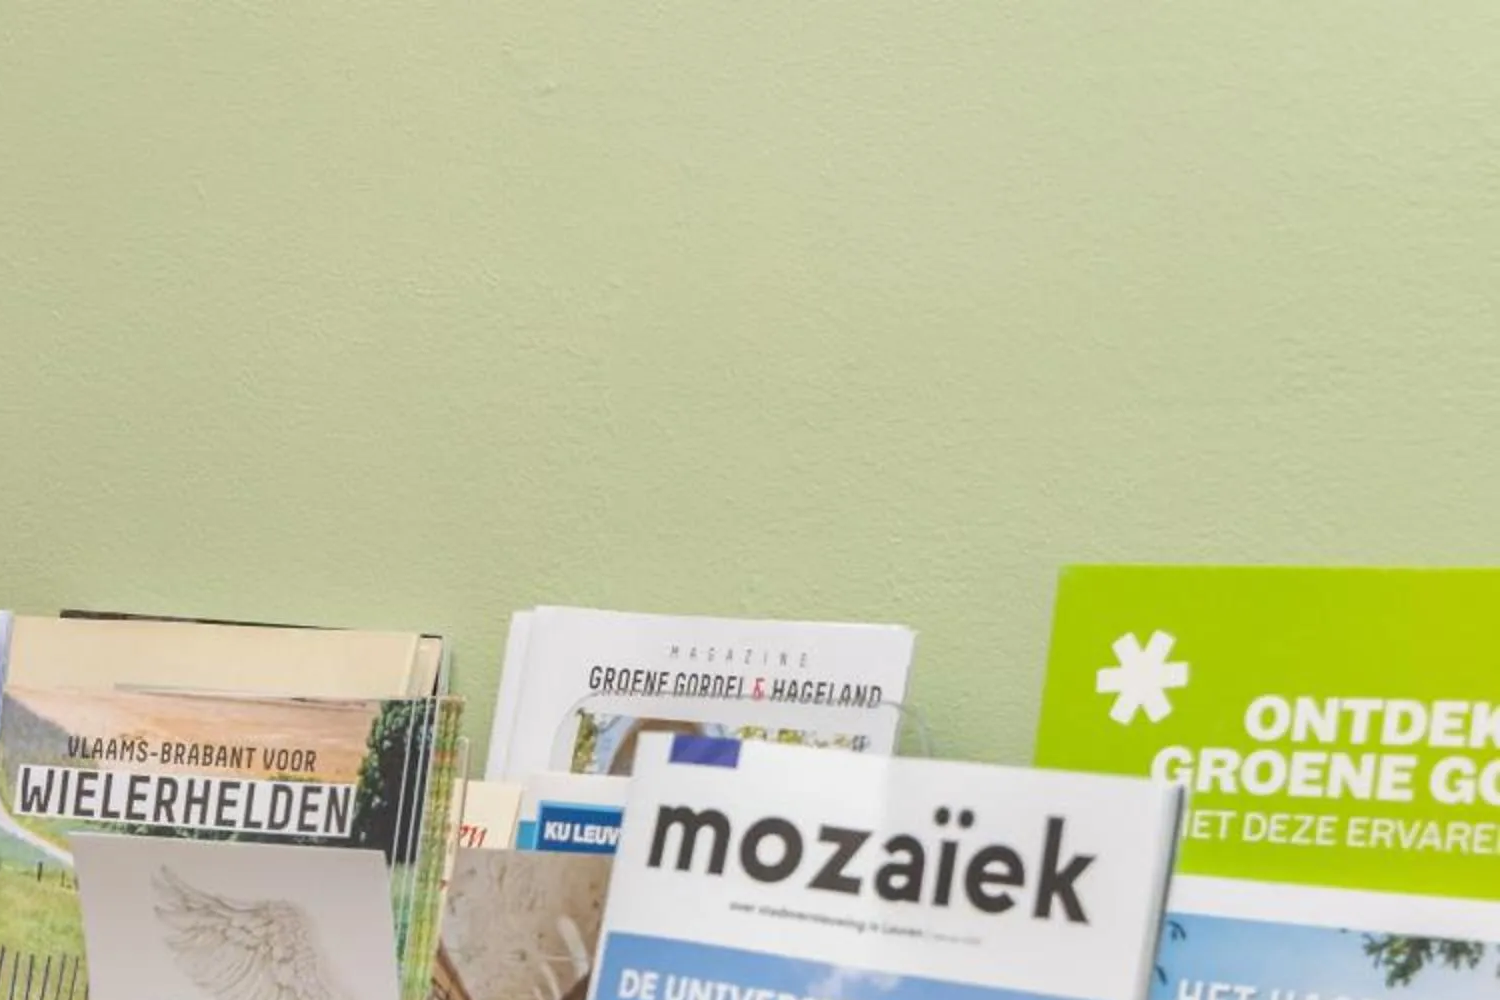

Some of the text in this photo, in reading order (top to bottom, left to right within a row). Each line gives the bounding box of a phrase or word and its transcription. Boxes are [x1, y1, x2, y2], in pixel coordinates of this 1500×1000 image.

[670, 645, 809, 668] MAGAZINE
[770, 679, 883, 709] HAGELAND
[67, 735, 317, 773] VLAAMS-BRABANT VOOR
[1150, 746, 1418, 802] GROENE
[20, 766, 352, 835] WIELERHELDEN
[544, 820, 570, 841] KU
[1182, 810, 1500, 856] ET DEZE ERVARE
[646, 804, 1098, 926] mozaïek
